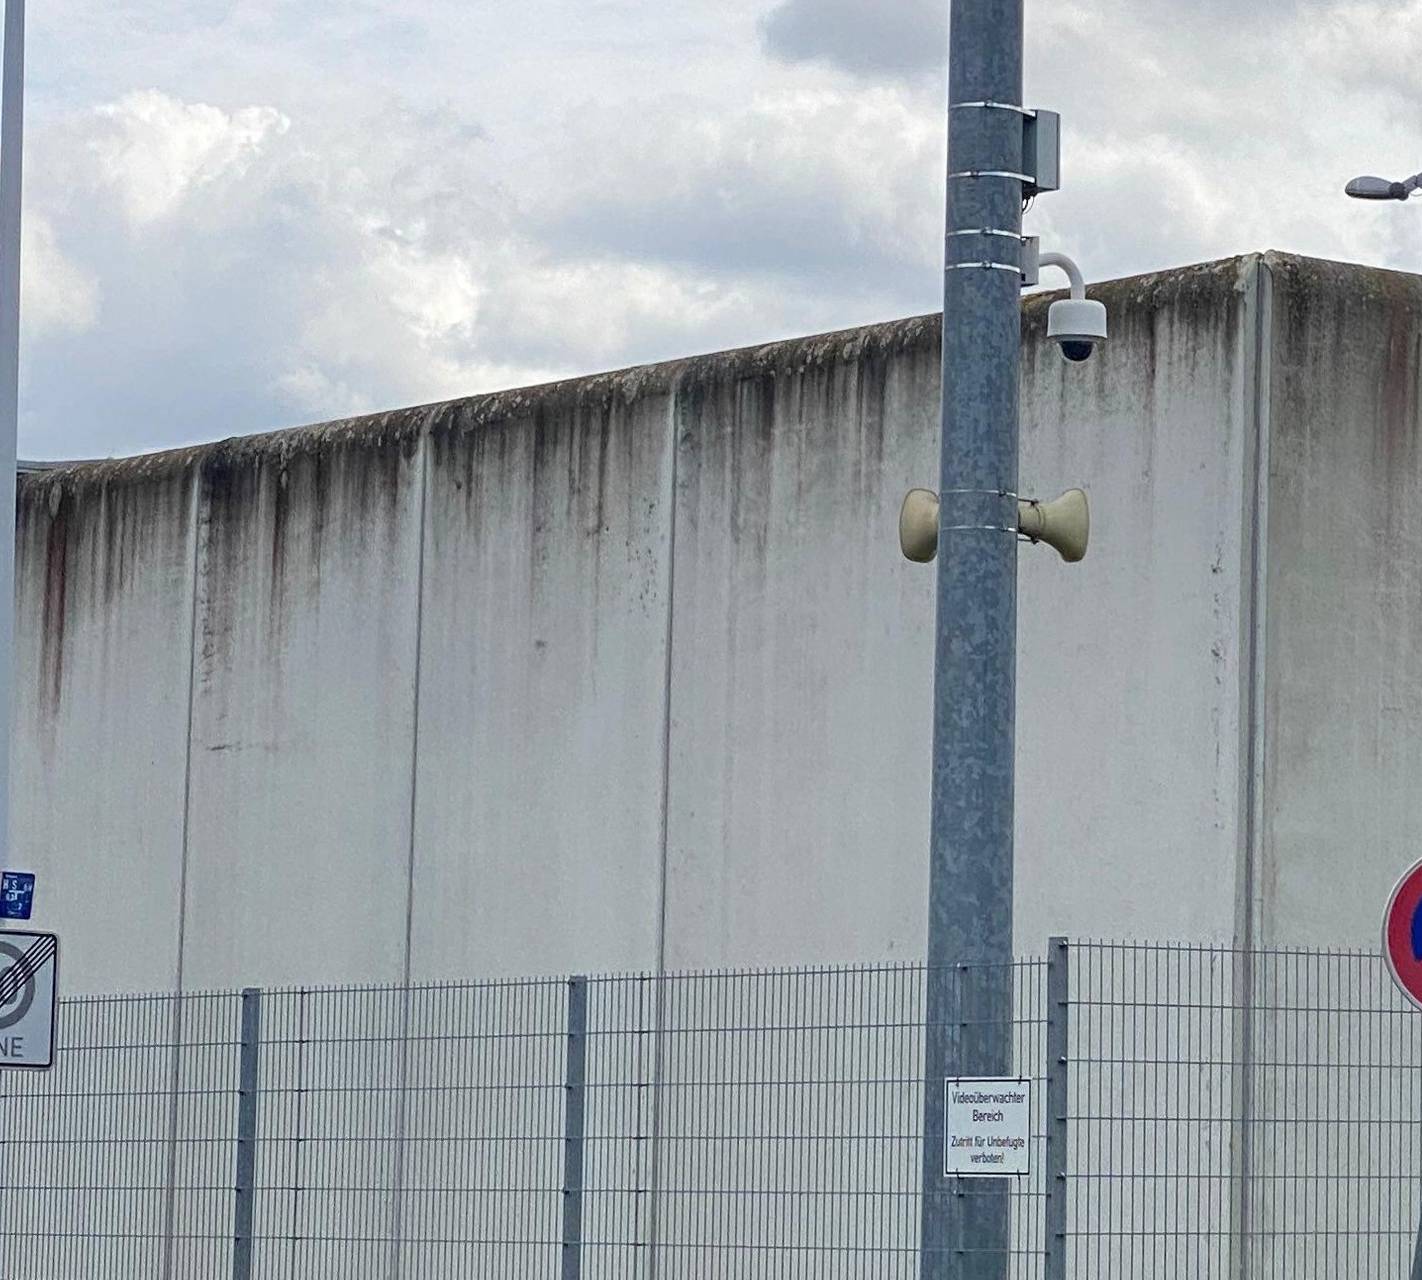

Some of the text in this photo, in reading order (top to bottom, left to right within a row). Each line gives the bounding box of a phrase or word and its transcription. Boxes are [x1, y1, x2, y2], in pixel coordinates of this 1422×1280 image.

[951, 1091, 1026, 1104] Videoüberwachter
[972, 1109, 1004, 1122] Bereich
[951, 1135, 1025, 1150] Zutritt für Unbefugte
[970, 1152, 1004, 1164] verboten!
